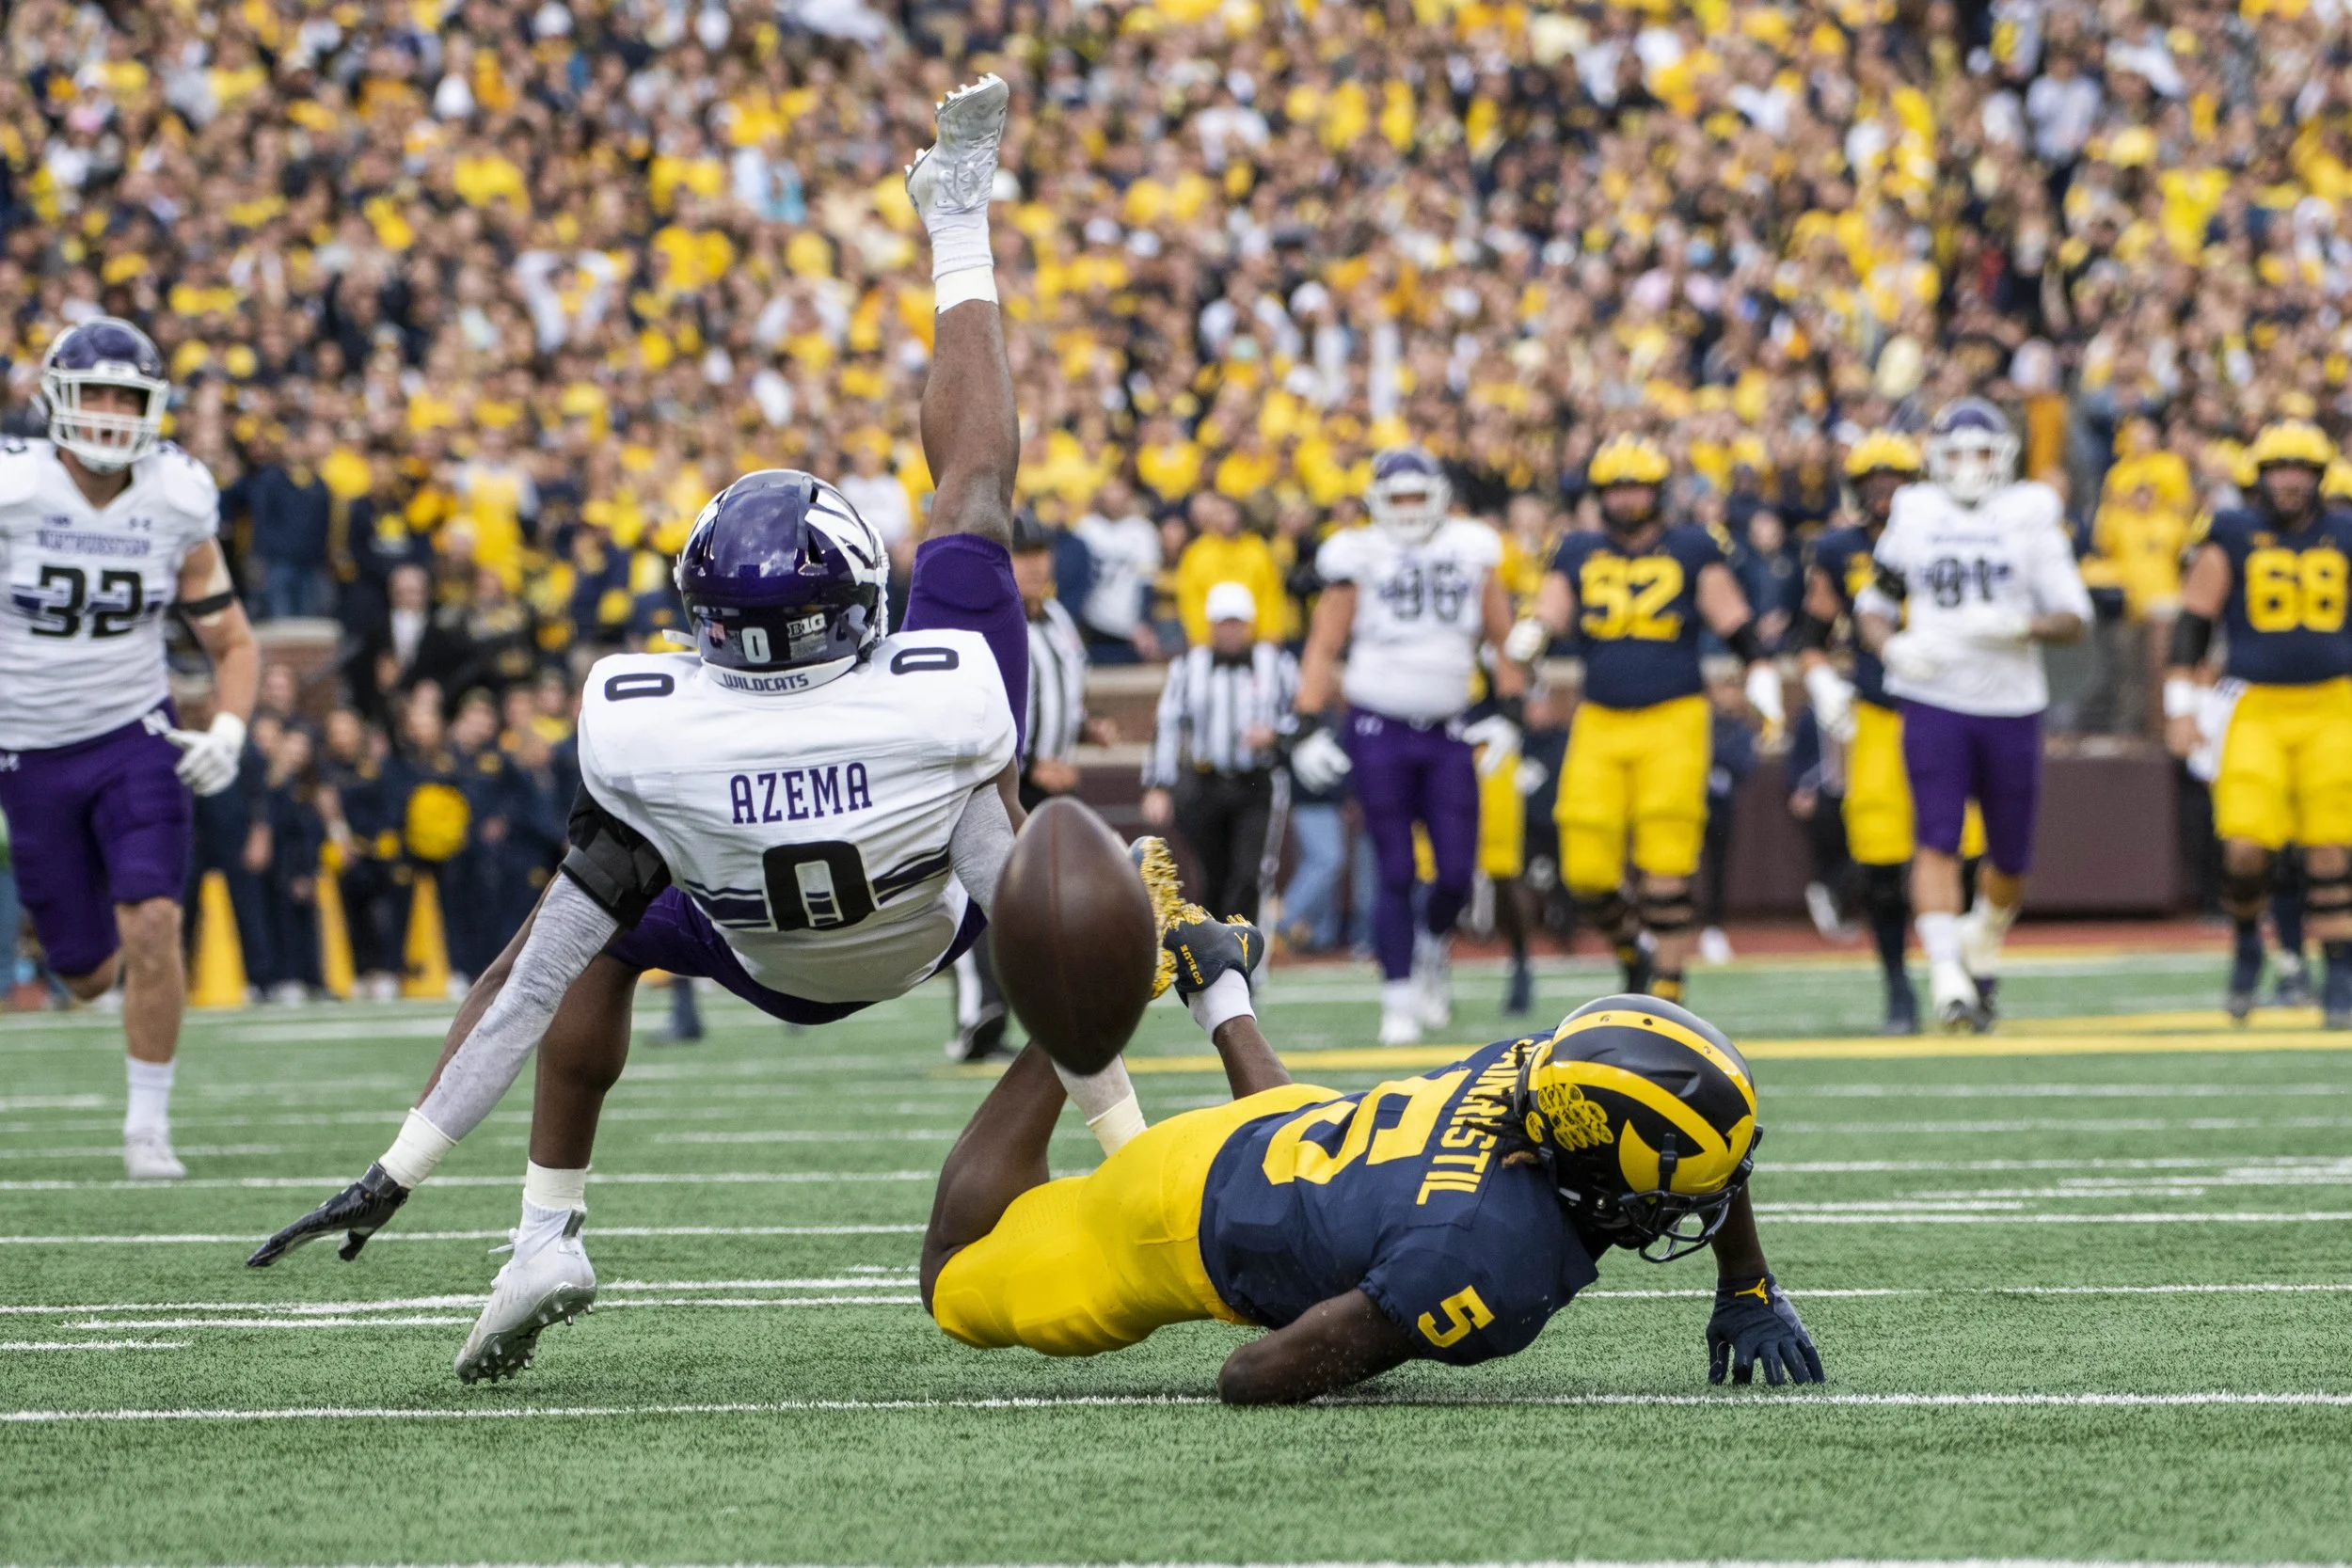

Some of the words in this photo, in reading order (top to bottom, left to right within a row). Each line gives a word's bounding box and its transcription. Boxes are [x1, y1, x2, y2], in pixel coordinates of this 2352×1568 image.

[30, 564, 143, 640] 32
[2244, 547, 2349, 633] 68
[741, 626, 772, 664] 0
[889, 646, 960, 676] 0
[603, 673, 675, 702] 0
[723, 673, 809, 692] WILDCATS
[729, 762, 873, 825] AZEMA
[762, 839, 881, 932] 0
[1262, 1068, 1472, 1185] 5
[1418, 1285, 1495, 1348] 5
